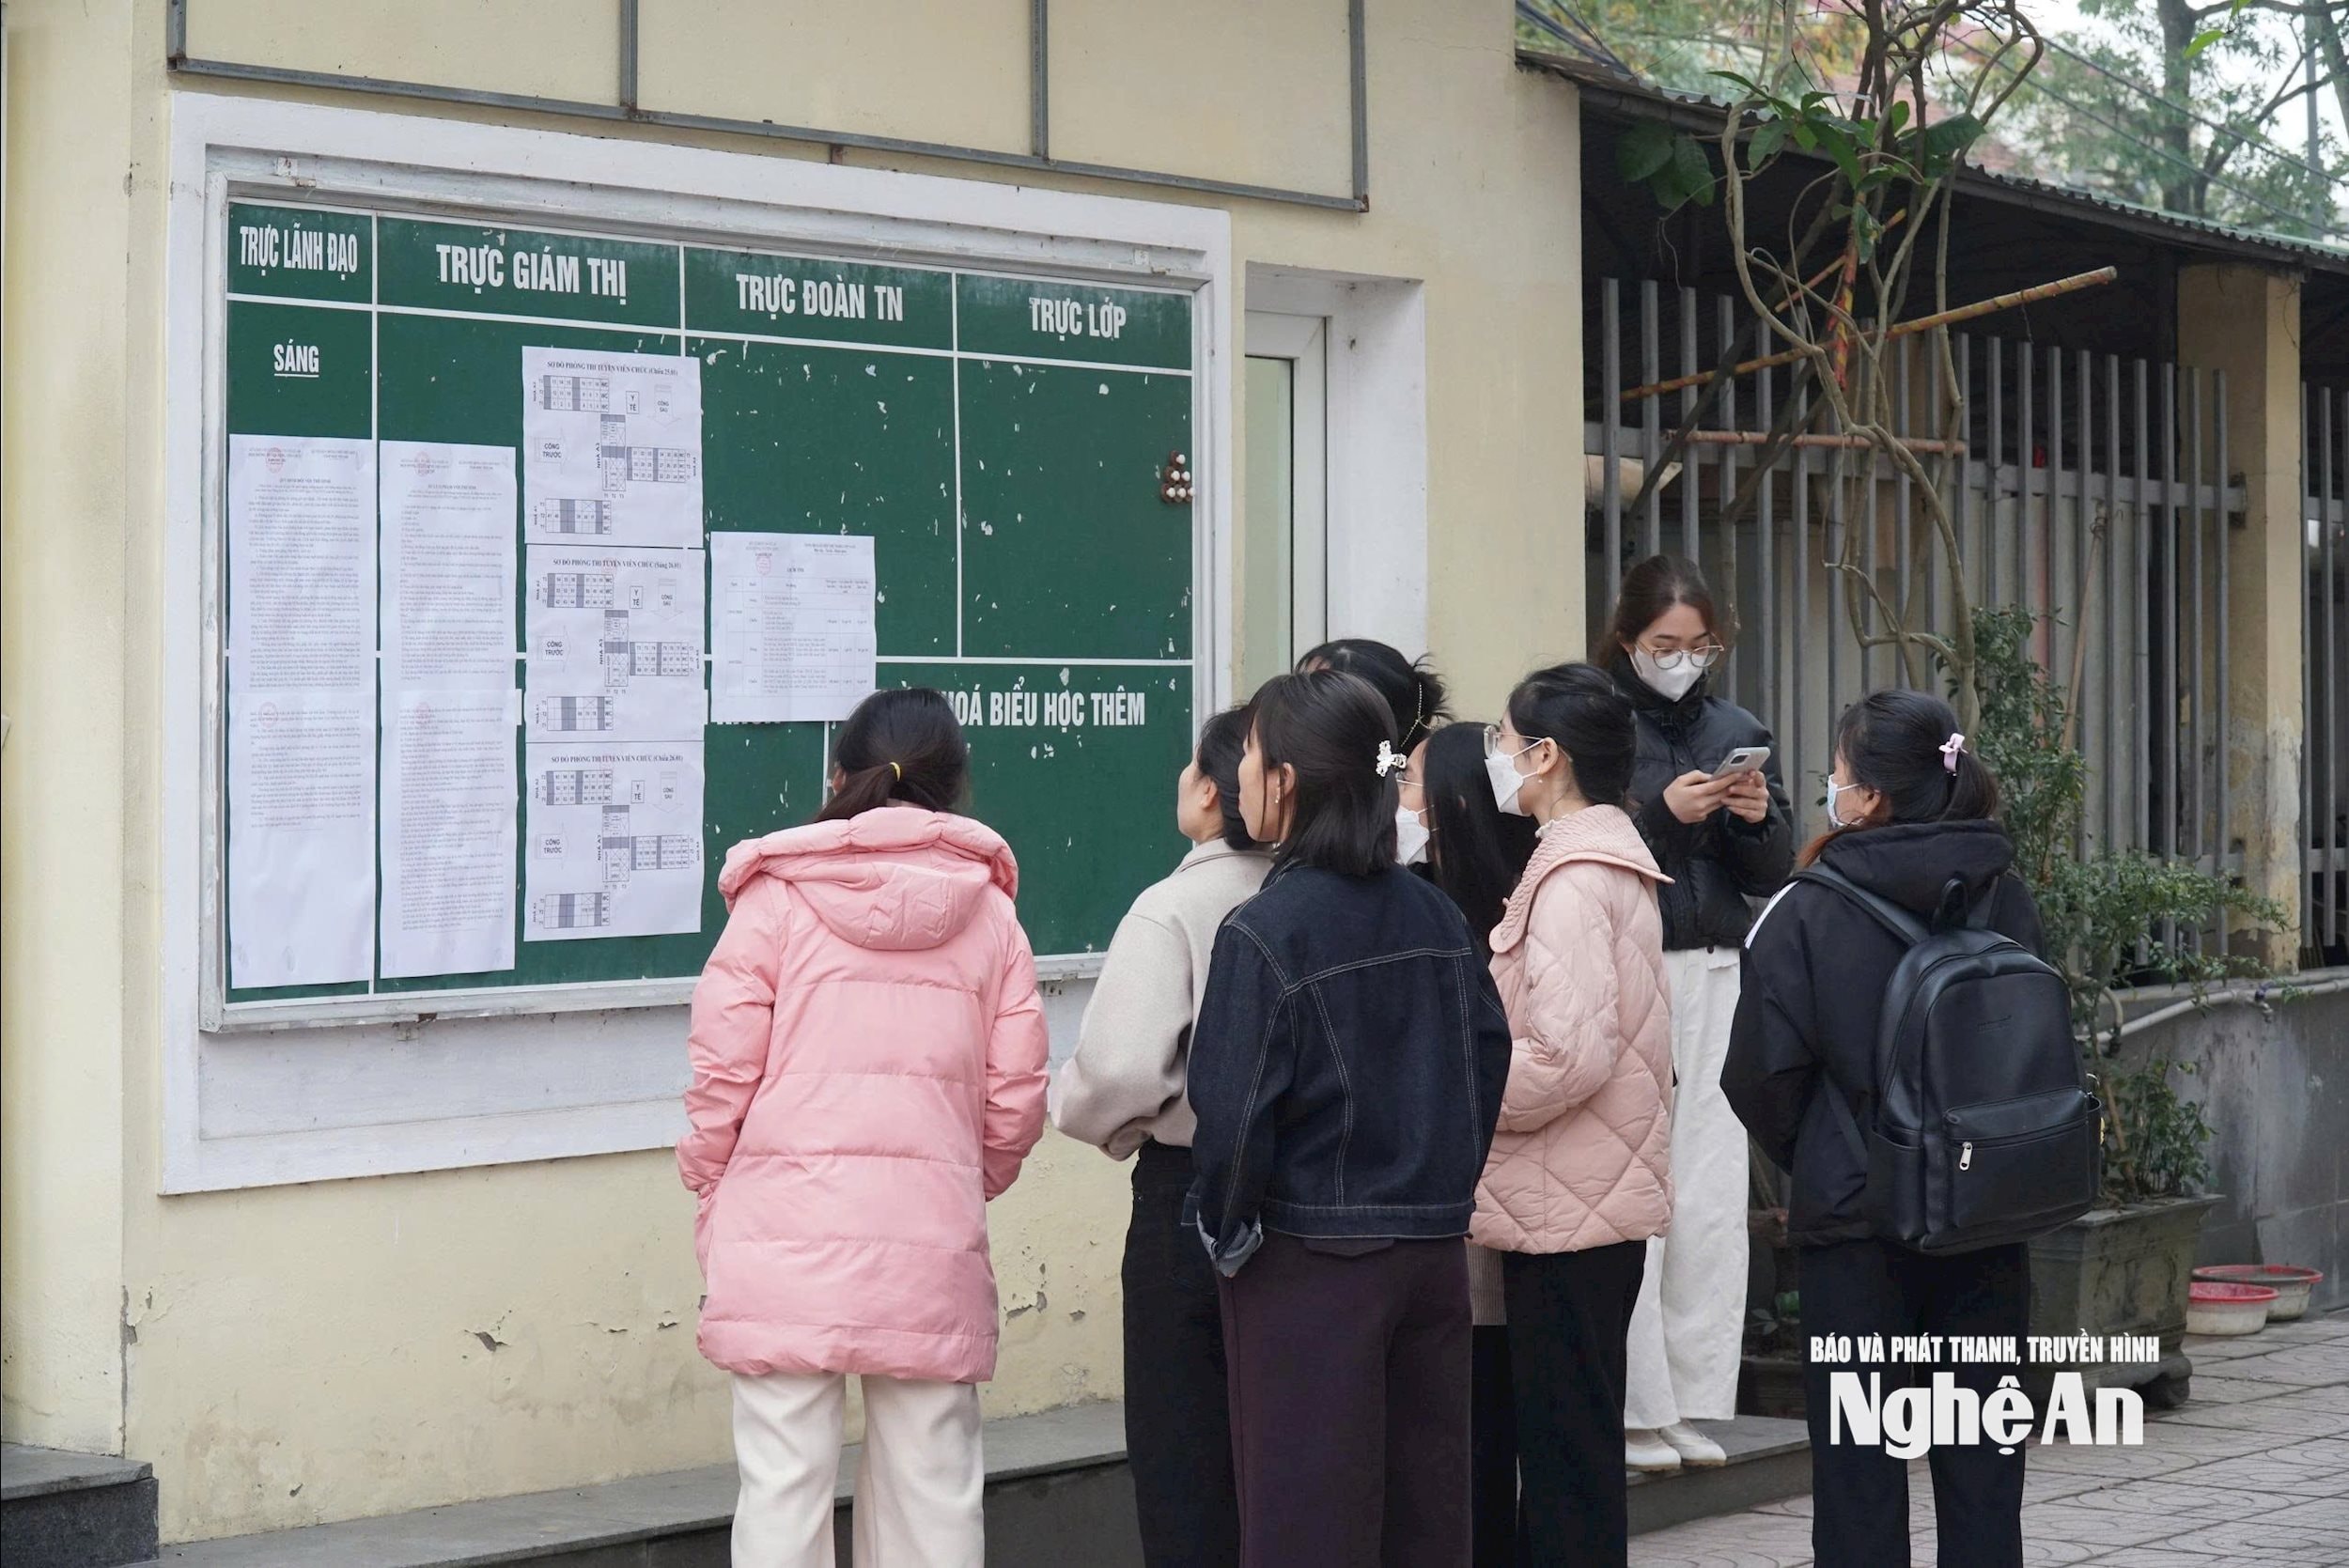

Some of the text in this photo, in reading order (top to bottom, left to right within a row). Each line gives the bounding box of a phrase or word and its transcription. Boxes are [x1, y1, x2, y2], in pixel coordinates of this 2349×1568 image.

[241, 223, 358, 281] TRỰC LÃNH ĐẠO
[436, 244, 627, 305] TRỰC GIÁM THỊ
[736, 273, 903, 321] TRỰC ĐOÀN TN
[1029, 297, 1127, 342] TRỰC LỚP
[273, 338, 319, 373] SÁNG
[934, 675, 1145, 734] OÁ BIỂU HỌC THÊM
